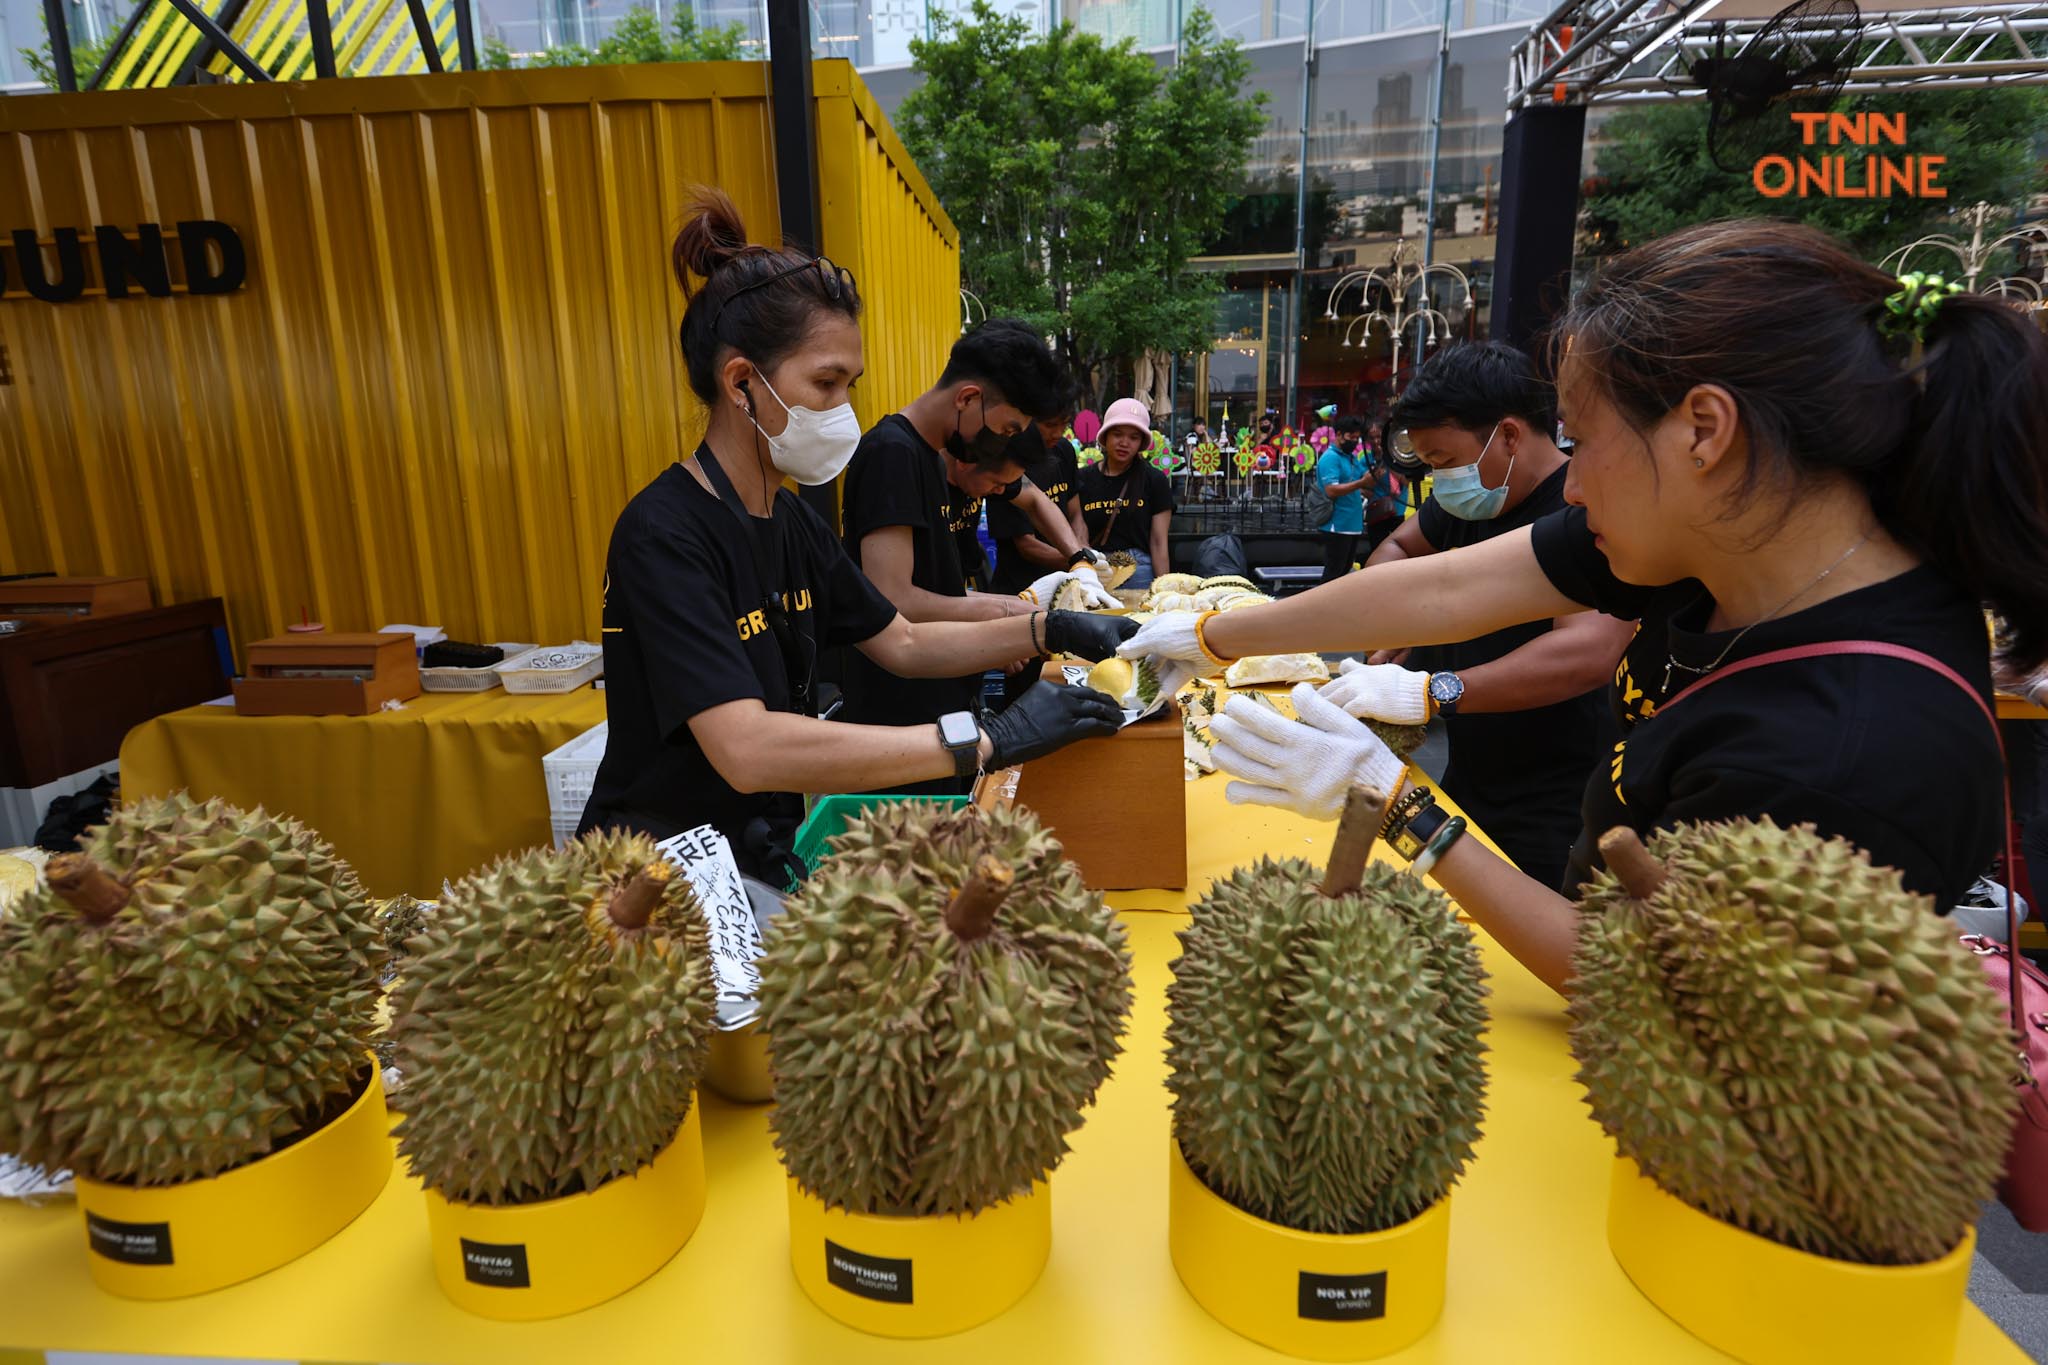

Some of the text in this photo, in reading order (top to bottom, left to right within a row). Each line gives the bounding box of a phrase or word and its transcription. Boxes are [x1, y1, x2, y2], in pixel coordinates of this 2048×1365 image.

[0, 220, 247, 302] UND
[832, 1256, 898, 1282] MONTHONG
[1316, 1287, 1372, 1299] NOK YIP
